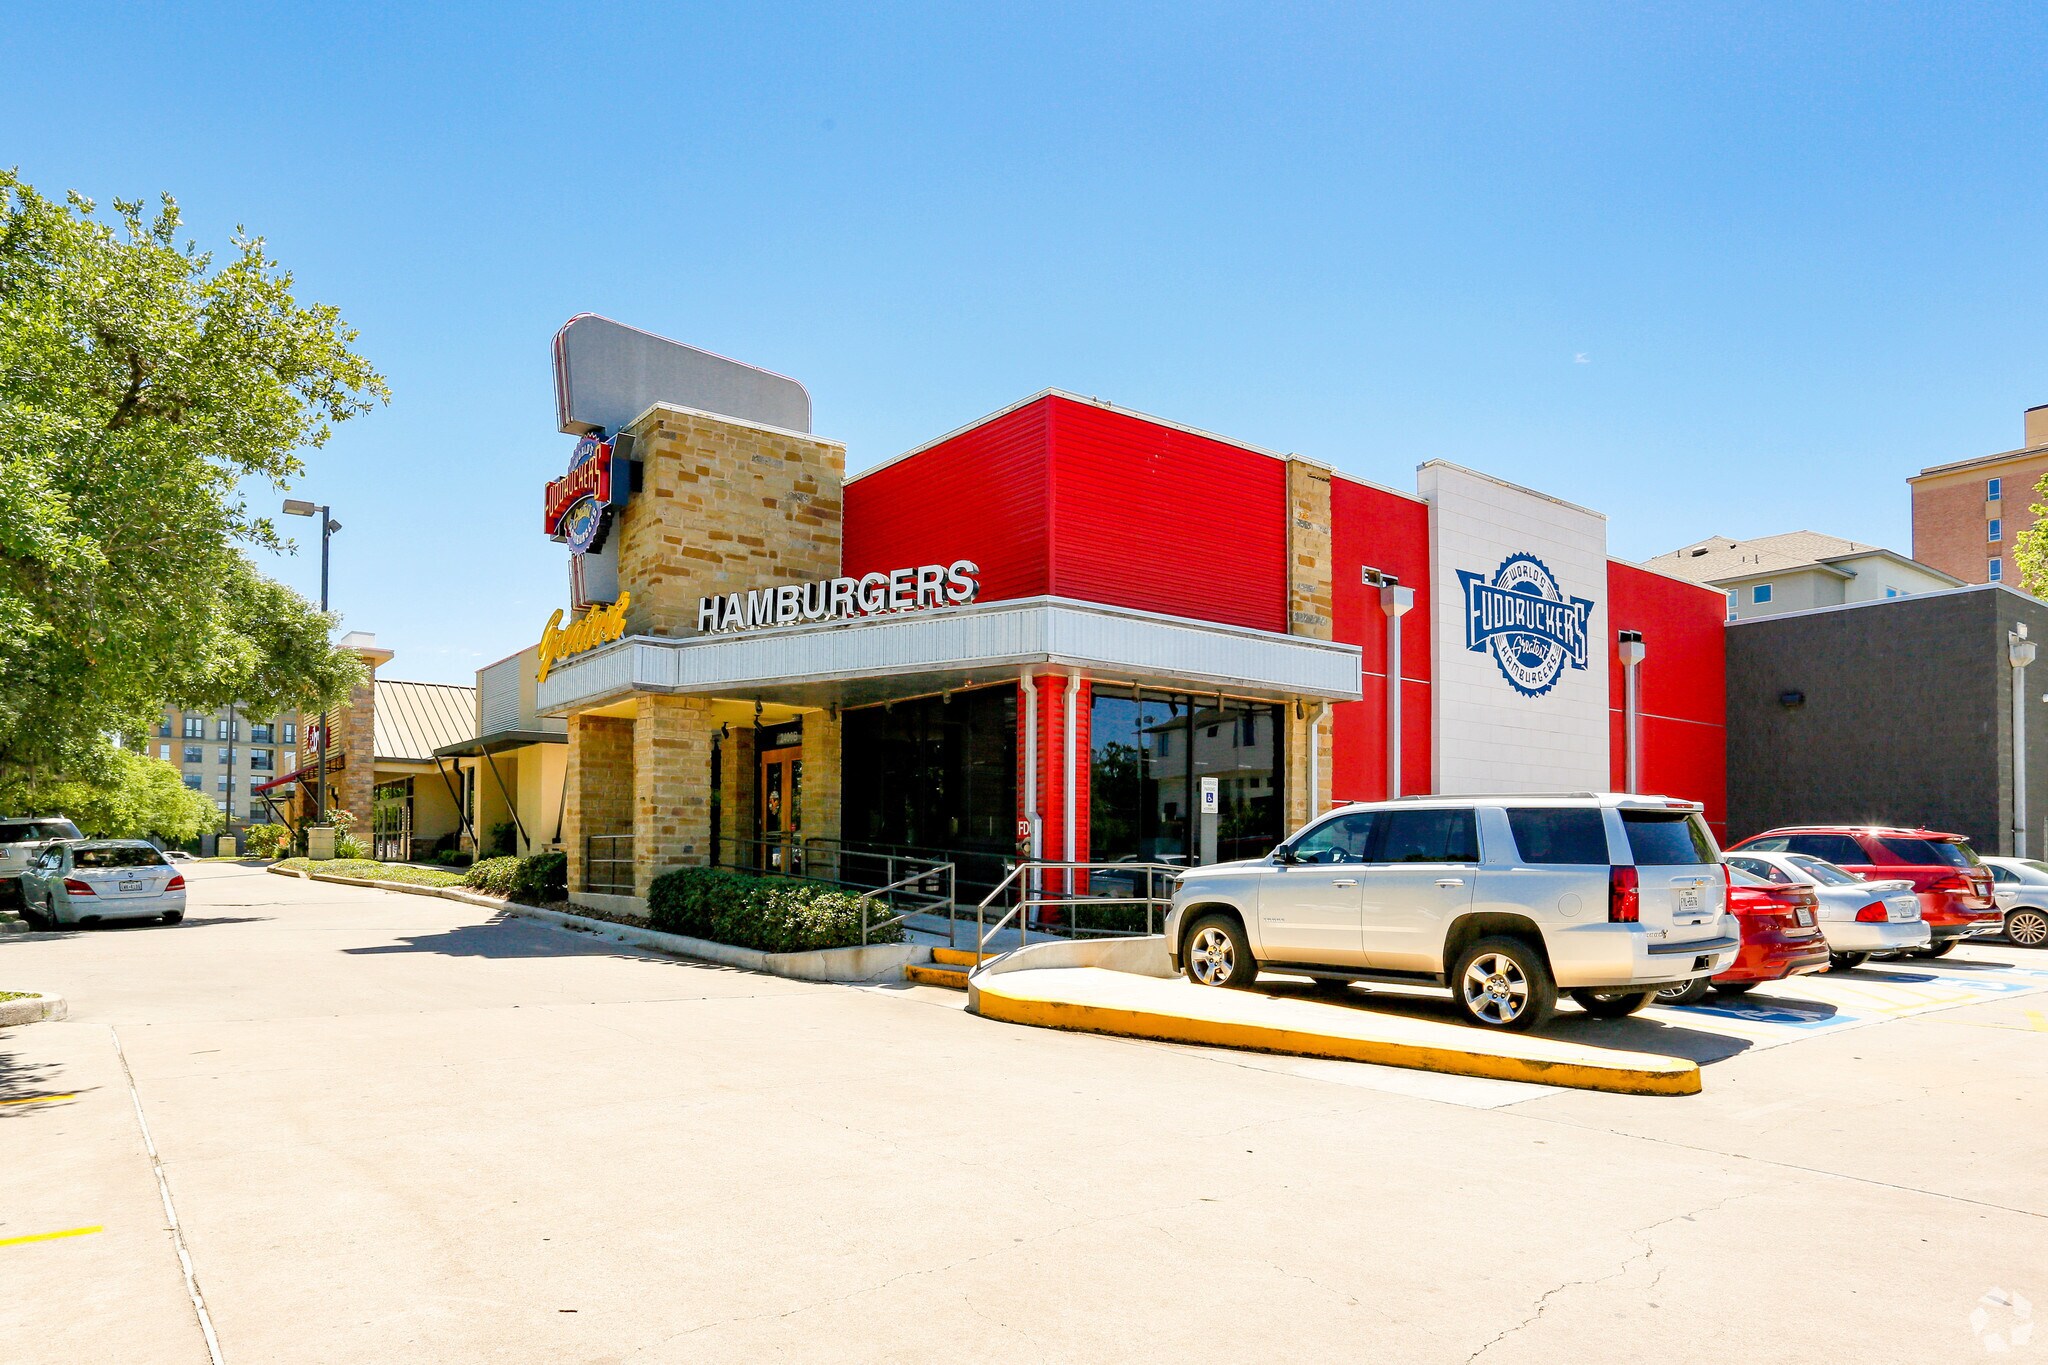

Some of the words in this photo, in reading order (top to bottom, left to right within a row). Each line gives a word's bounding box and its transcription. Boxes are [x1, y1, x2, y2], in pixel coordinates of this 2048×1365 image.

[1509, 565, 1546, 588] WORLD'S
[697, 559, 980, 634] HAMBURGERS
[537, 590, 631, 683] Greatest
[1469, 578, 1586, 665] FUDDRUCKERS
[1501, 645, 1558, 684] HAMBURGERS
[1510, 635, 1551, 660] Greatest
[1018, 821, 1032, 836] FD
